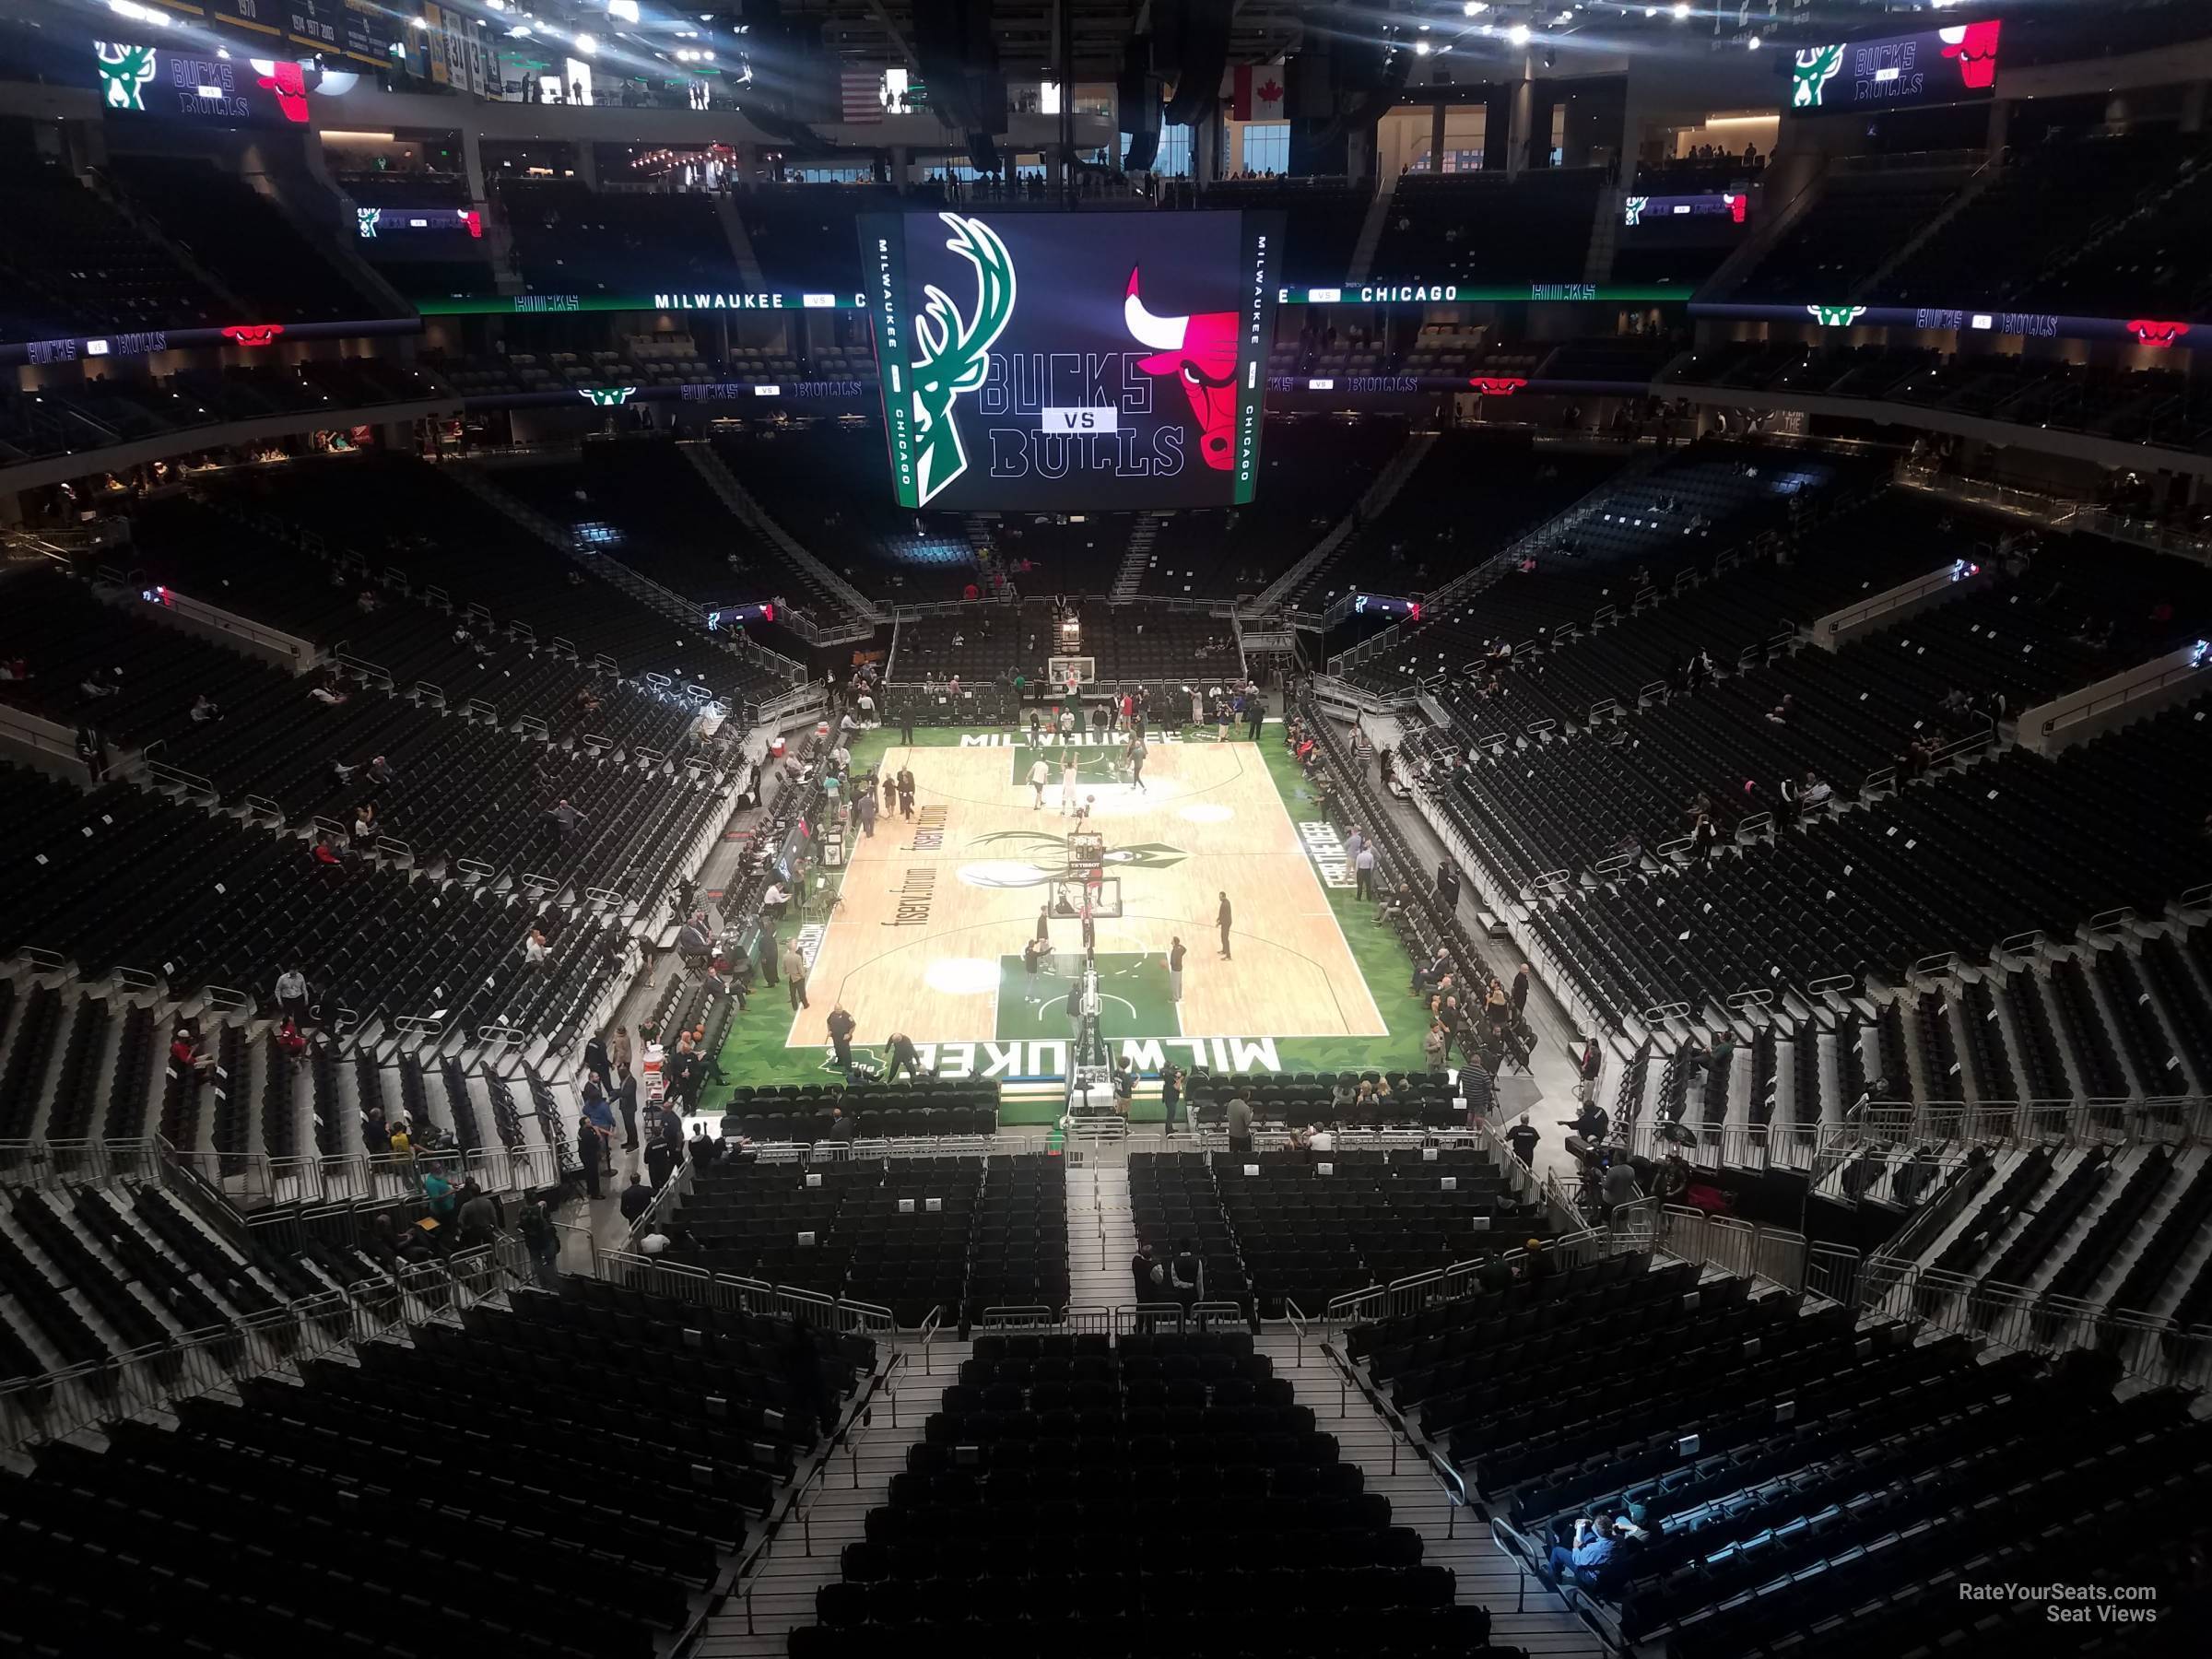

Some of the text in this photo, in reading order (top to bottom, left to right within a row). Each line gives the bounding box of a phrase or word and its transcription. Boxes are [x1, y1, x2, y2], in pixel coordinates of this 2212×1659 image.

[321, 23, 335, 41] 2003
[451, 37, 464, 68] 31
[1854, 41, 1916, 76] BUCKS
[171, 58, 235, 91] BUCKS
[1853, 73, 1924, 100] BULLS
[179, 93, 250, 117] BULLS
[654, 294, 783, 309] MILWAUKEE
[879, 239, 897, 348] MILWAUKEE
[1251, 236, 1266, 345] MILWAUKEE
[1361, 286, 1457, 301] CHICAGO
[26, 338, 76, 365] BUCKS
[980, 352, 1152, 415] BUCKS
[1064, 411, 1095, 429] VS
[895, 408, 911, 485] CHICAGO
[989, 425, 1184, 478] BULLS
[1241, 405, 1254, 480] CHICAGO
[900, 805, 949, 851] fiserv.forum
[880, 867, 937, 926] fiserv.forum
